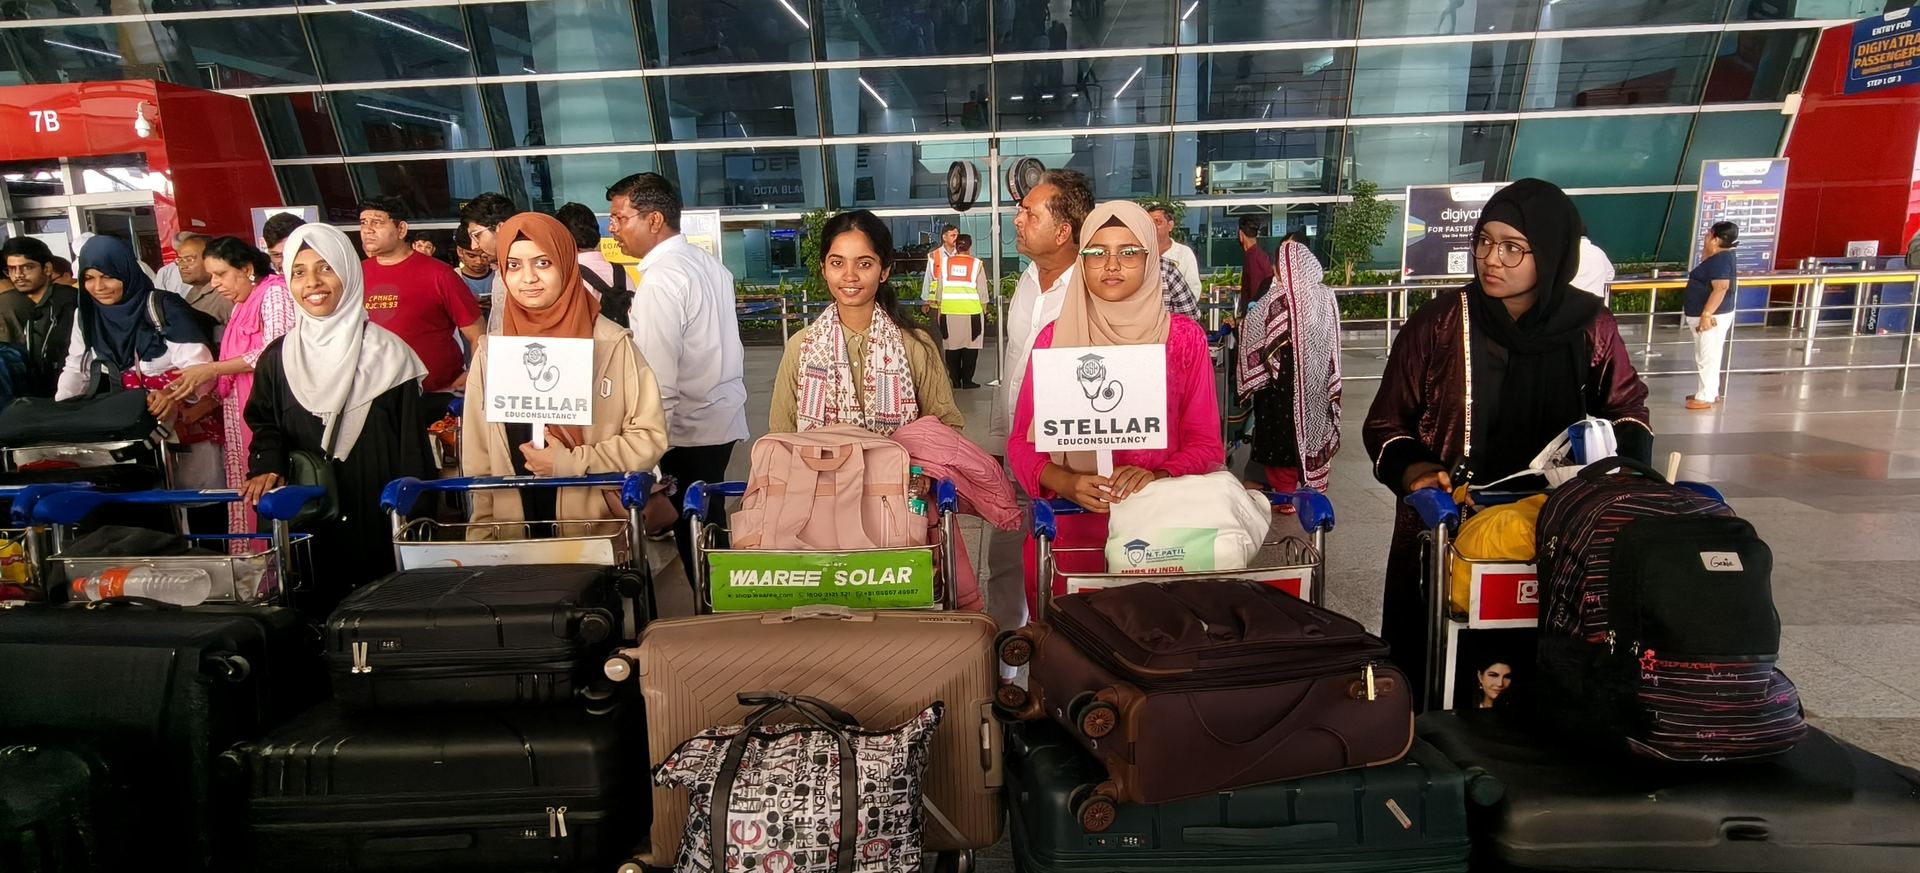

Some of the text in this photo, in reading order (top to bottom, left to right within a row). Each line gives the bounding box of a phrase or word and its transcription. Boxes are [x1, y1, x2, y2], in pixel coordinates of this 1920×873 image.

[1872, 20, 1912, 36] ENTRY FOR
[1857, 32, 1920, 57] DIGIYATRA
[1866, 78, 1883, 88] STEP
[1887, 75, 1897, 84] OF
[29, 110, 60, 133] 7B
[1441, 207, 1482, 223] digiyat
[1445, 225, 1474, 233] FASTER
[493, 395, 589, 412] STELLAR
[504, 411, 577, 420] EDUCONSULTANCY
[1043, 416, 1160, 436] STELLAR
[1057, 436, 1148, 446] EDUCONSULTANCY
[730, 566, 913, 587] WAAREE SOLAR
[1159, 565, 1184, 574] INDIA
